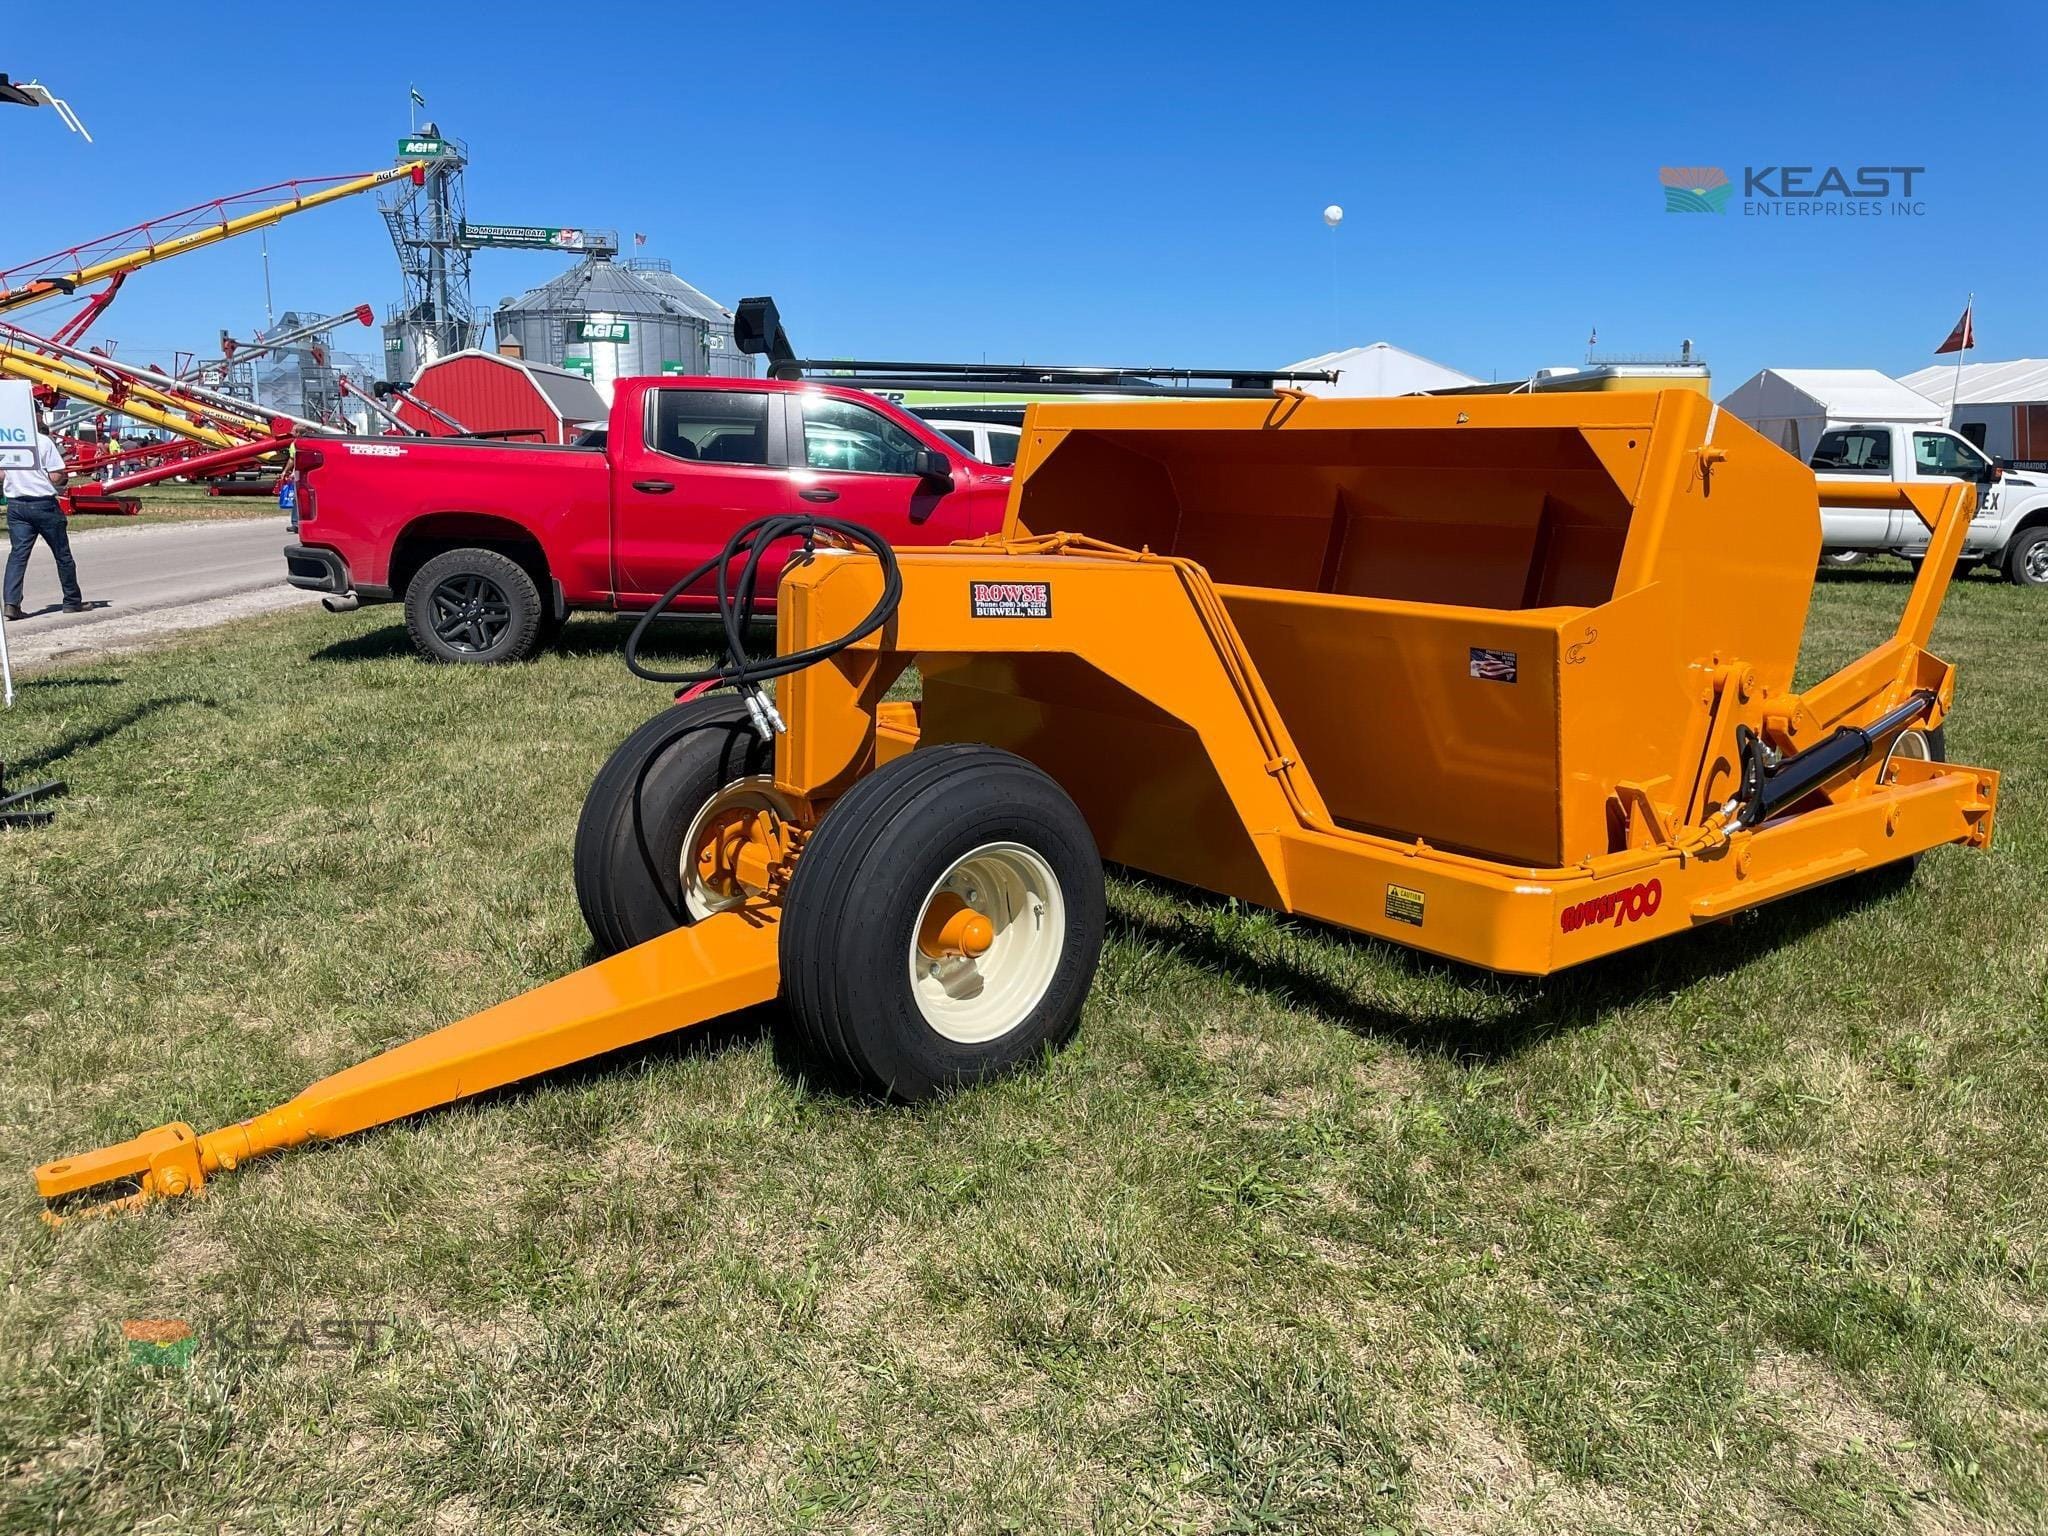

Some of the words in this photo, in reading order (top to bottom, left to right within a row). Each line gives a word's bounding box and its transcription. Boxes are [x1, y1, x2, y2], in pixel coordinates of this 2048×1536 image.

[406, 142, 427, 152] AGI
[376, 171, 392, 182] AGI
[466, 226, 478, 234] DO
[479, 227, 503, 235] MORE
[504, 228, 525, 237] WITH
[525, 229, 546, 237] DATA
[582, 324, 612, 338] AGI
[2013, 461, 2047, 470] SEPARATORS
[974, 585, 1047, 602] ROWSE
[976, 607, 1025, 617] BURWELL,
[1027, 607, 1047, 617] NEB
[1400, 890, 1421, 902] CAUTION
[1560, 892, 1616, 934] ROWSE
[1613, 878, 1662, 928] 700
